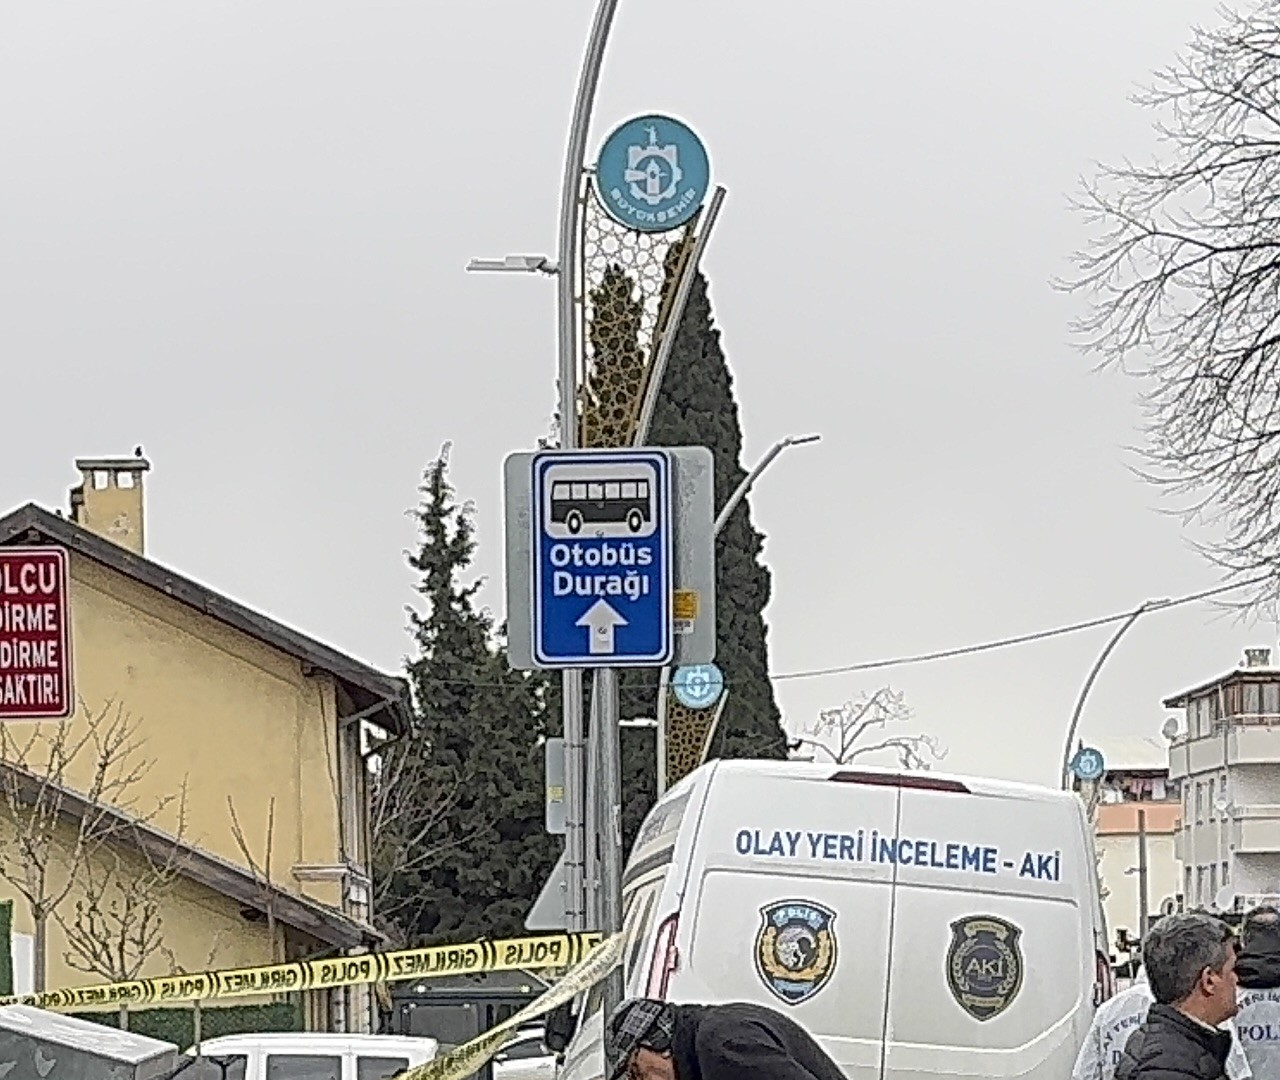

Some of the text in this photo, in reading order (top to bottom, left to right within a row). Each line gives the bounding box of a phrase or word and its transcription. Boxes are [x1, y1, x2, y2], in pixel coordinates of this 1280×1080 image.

[550, 543, 652, 567] Otobüs
[553, 570, 649, 601] Durağı
[737, 830, 800, 858] OLAY
[807, 830, 863, 862] YERİ
[870, 830, 998, 873] İNCELEME
[1019, 850, 1060, 882] AKİ
